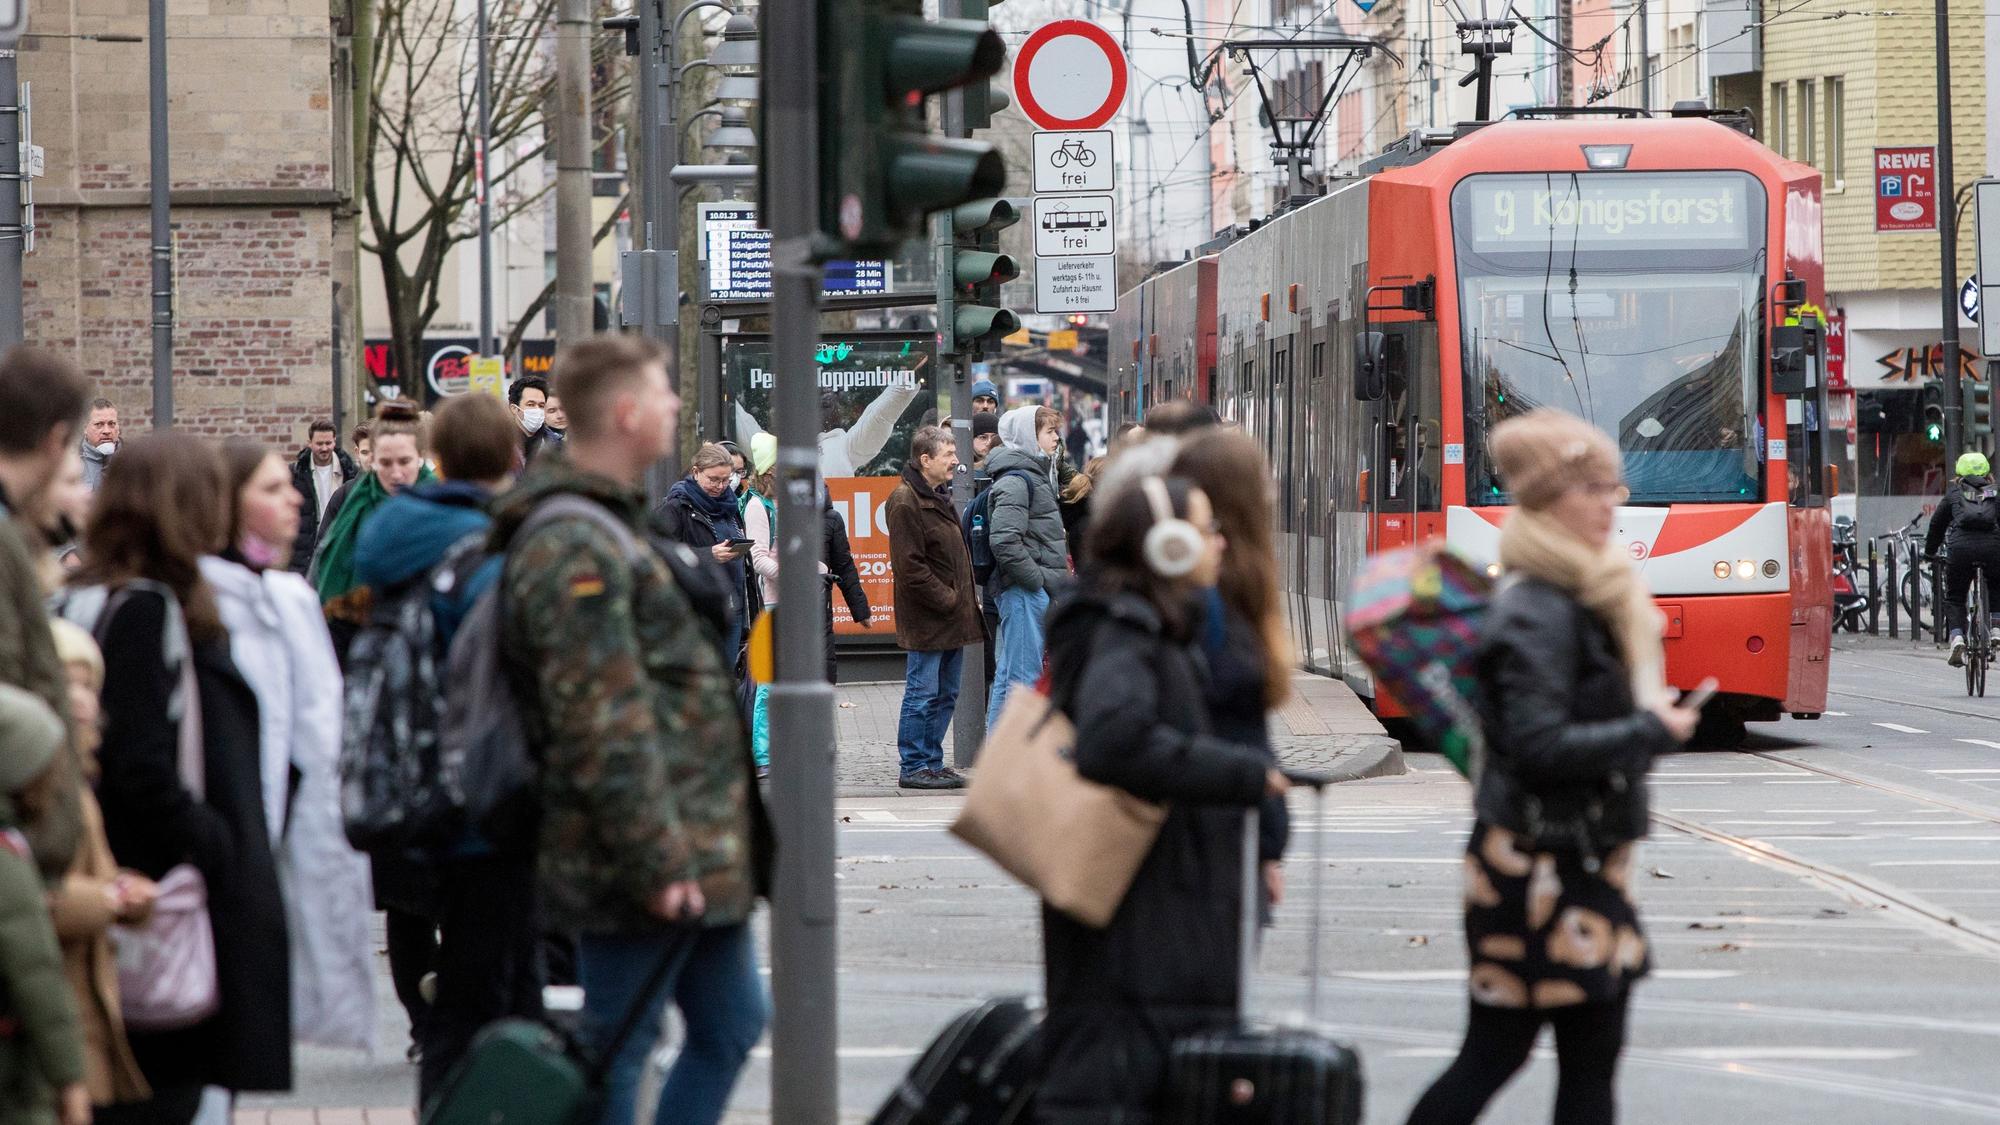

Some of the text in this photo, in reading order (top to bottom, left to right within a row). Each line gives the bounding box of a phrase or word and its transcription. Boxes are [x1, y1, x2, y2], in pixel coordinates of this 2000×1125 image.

[1878, 153, 1932, 169] REWE
[1061, 171, 1087, 185] frei
[1493, 187, 1736, 236] 9 Königsforst
[740, 232, 774, 240] Deutz/M
[731, 241, 771, 250] Königsforst
[1063, 235, 1088, 249] frei
[731, 251, 771, 259] Königsforst
[740, 261, 774, 269] Deutz/M
[855, 260, 881, 268] 24 Min
[731, 270, 772, 279] Königsforst
[855, 270, 865, 278] 28
[1051, 274, 1077, 283] werktags
[731, 280, 772, 289] Königsforst
[855, 279, 882, 287] 38 Min
[1052, 285, 1073, 293] Zufahrt
[729, 290, 761, 298] Minuten
[1065, 296, 1070, 304] 6
[816, 366, 916, 392] loppenburg
[878, 577, 890, 585] top
[870, 605, 895, 613] Onlin
